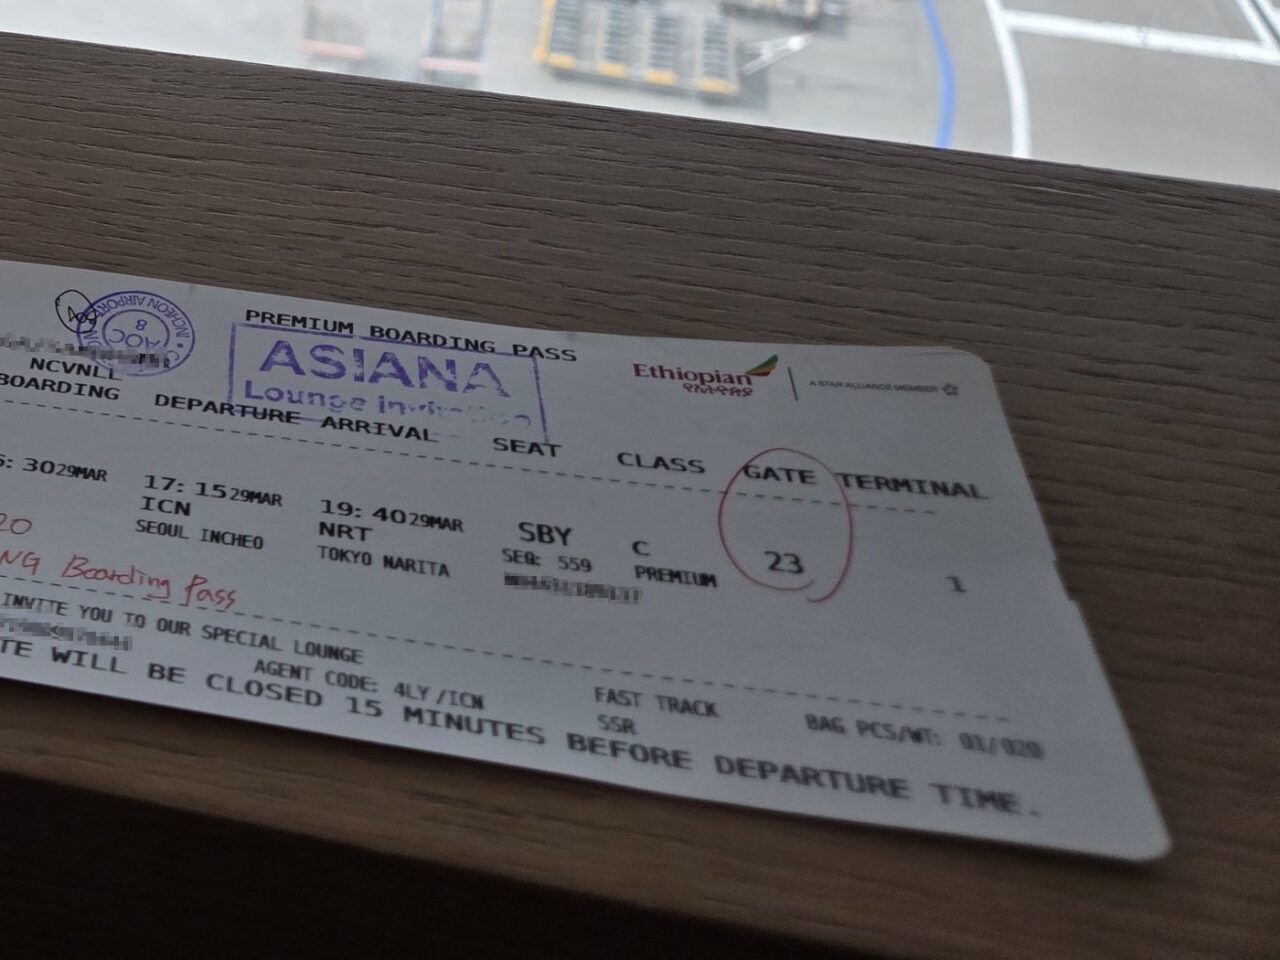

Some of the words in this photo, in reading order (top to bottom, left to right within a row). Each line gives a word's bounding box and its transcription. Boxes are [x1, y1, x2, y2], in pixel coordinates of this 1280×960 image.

[135, 318, 148, 331] 8
[148, 298, 190, 339] INCHEON
[246, 309, 354, 334] PREMIUM
[370, 325, 495, 354] BOARDING
[512, 343, 577, 362] PASS
[108, 328, 160, 349] AOC
[29, 357, 123, 381] NCVNLL
[259, 339, 511, 398] ASIANA
[633, 364, 753, 385] Ethiopian
[244, 380, 368, 413] Lounge
[154, 393, 302, 425] DEPARTURE
[321, 417, 439, 443] ARRIVAL
[493, 437, 562, 458] SEAT
[617, 453, 706, 475] CLASS
[742, 464, 817, 486] GATE
[836, 472, 991, 500] TERMINAL
[135, 519, 190, 540] SEOUL
[200, 528, 264, 551] INCHEO
[317, 545, 372, 566] TOKYO
[383, 555, 451, 579] NARITA
[557, 556, 593, 574] 559
[634, 565, 719, 588] PREMIUM
[141, 496, 192, 517] ICN
[319, 521, 374, 542] NRT
[518, 521, 573, 547] SBY
[631, 540, 651, 557] C
[763, 550, 805, 575] 23
[946, 575, 967, 594] 1
[62, 554, 171, 599] Boarding
[184, 574, 237, 609] Pass
[3, 593, 69, 617] INVITE
[78, 604, 113, 623] YOU
[124, 611, 146, 630] TO
[156, 617, 191, 637] OUR
[201, 625, 283, 652] SPECIAL
[294, 639, 364, 665] LOUNGE
[253, 658, 317, 683] AGENT
[325, 670, 379, 694] CODE:
[594, 686, 642, 708] FAST
[657, 694, 719, 719] TRACK
[51, 645, 133, 676] WILL
[147, 662, 187, 685] BE
[205, 673, 325, 708] CLOSED
[345, 696, 384, 718] 15
[402, 705, 548, 746] MINUTES
[566, 732, 694, 771] BEFORE
[713, 754, 911, 802] DEPARTURE
[928, 782, 1042, 819] TIME.
[597, 714, 637, 736] SSR
[805, 713, 846, 736] BAG
